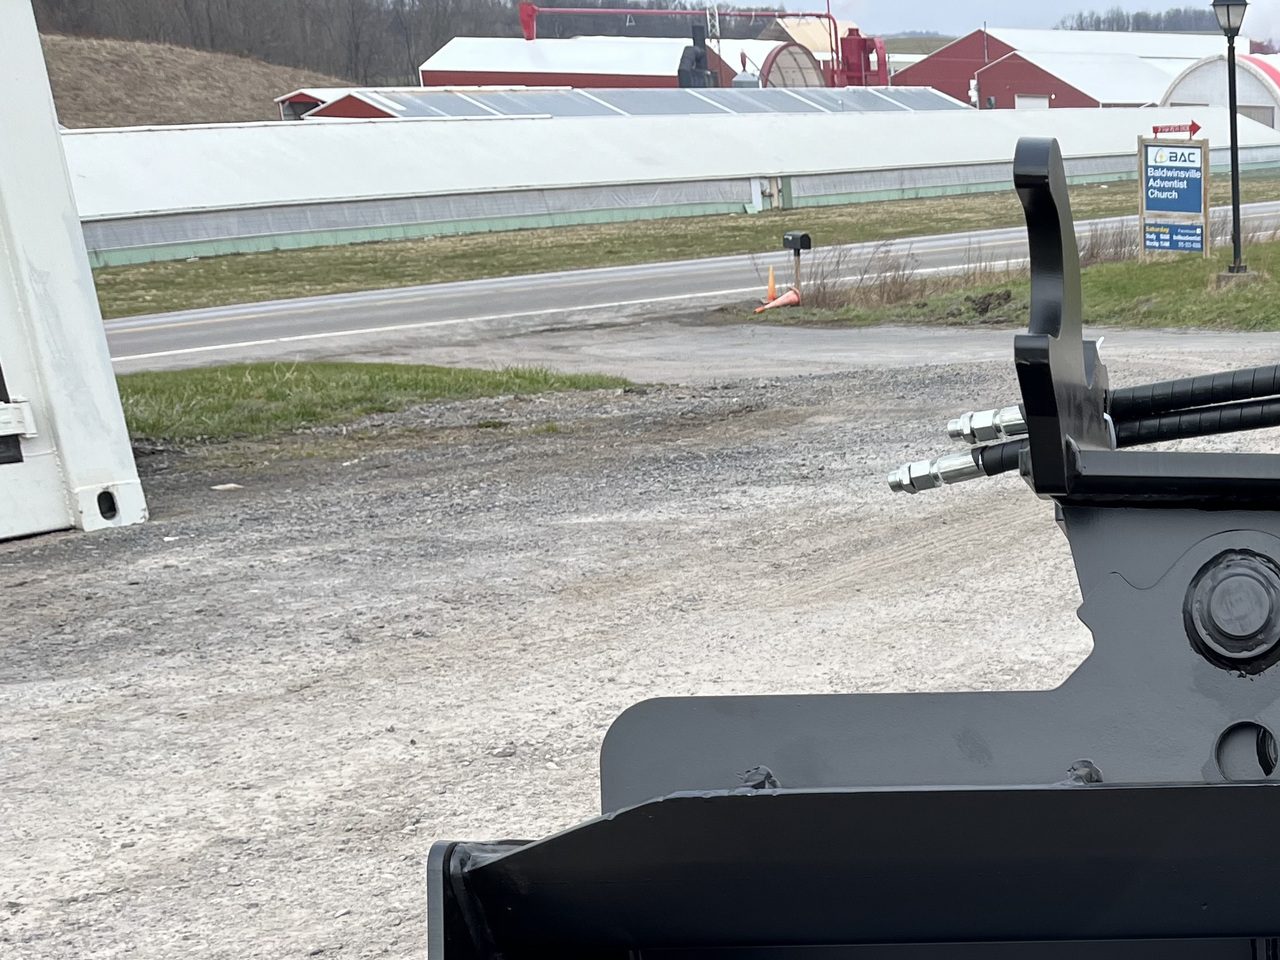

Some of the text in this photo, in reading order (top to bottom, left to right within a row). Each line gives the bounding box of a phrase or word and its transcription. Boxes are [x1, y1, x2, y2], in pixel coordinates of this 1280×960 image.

[1169, 152, 1196, 163] BAC
[1147, 167, 1201, 178] Baldwinsville
[1148, 178, 1187, 188] Adventist
[1148, 188, 1178, 199] Church
